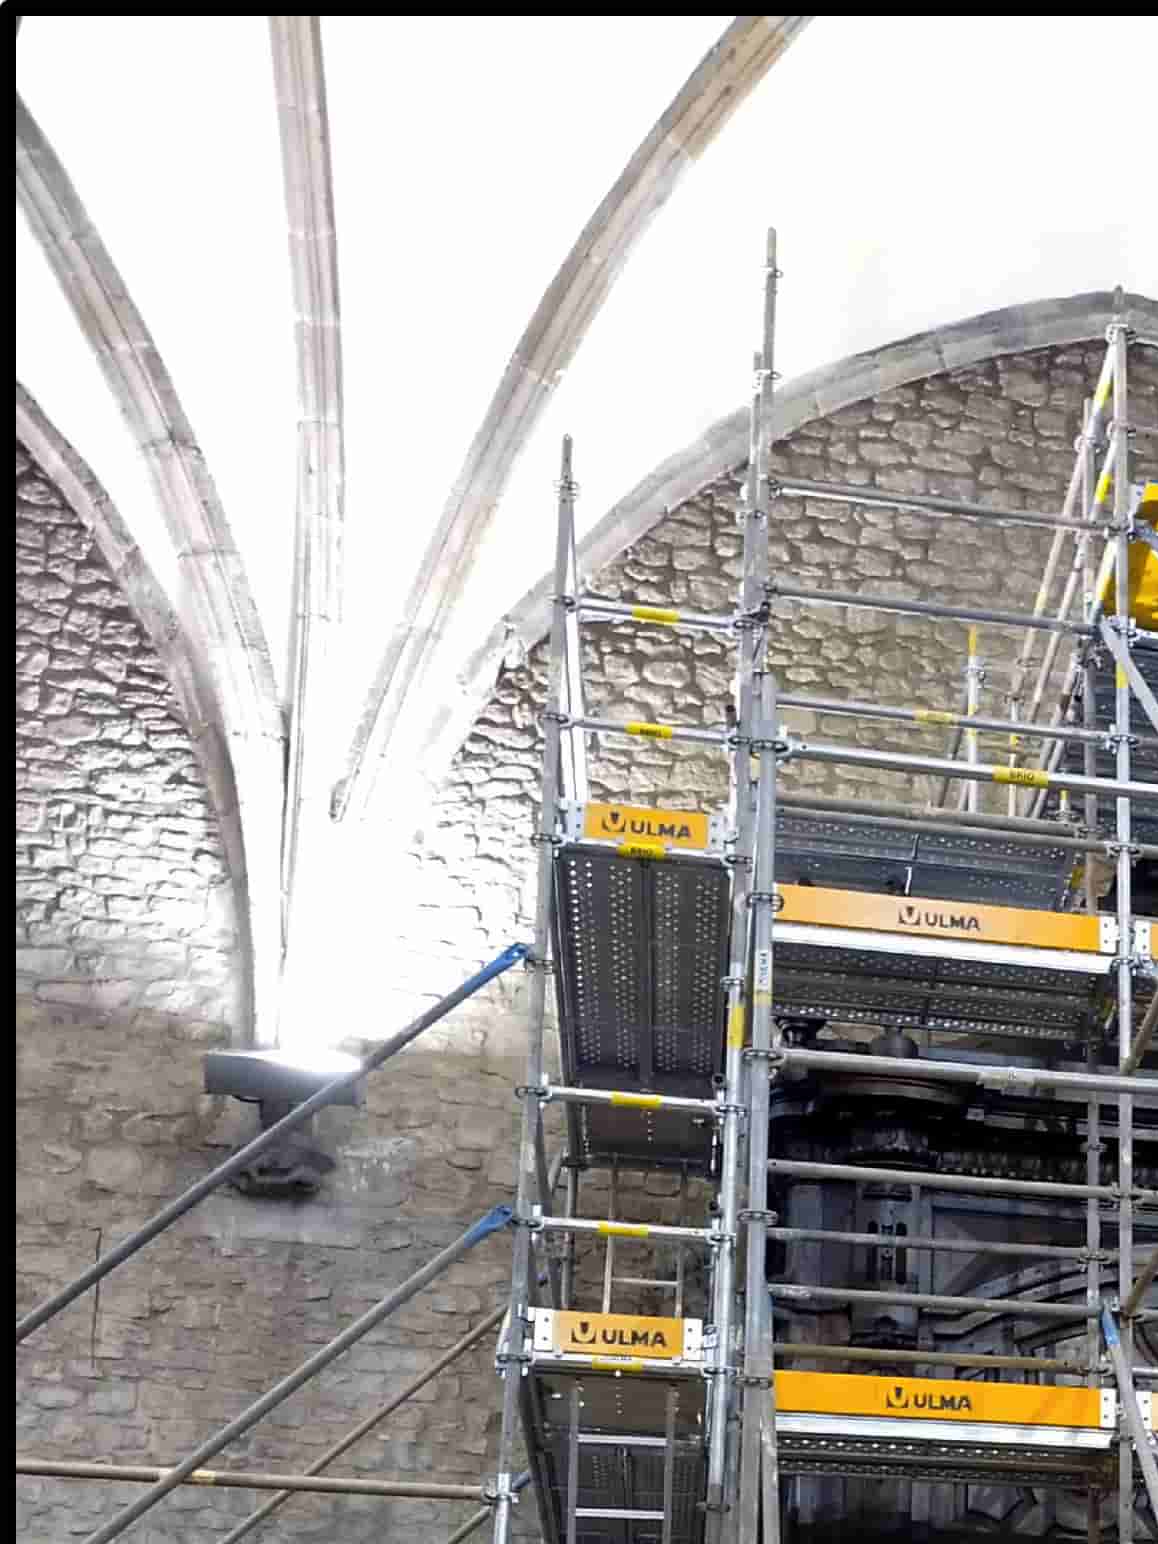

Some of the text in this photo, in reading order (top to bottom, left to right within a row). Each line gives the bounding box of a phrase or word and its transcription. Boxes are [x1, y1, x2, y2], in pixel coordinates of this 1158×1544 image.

[631, 820, 692, 838] ULMA
[925, 913, 981, 930] ULMA
[602, 1329, 667, 1347] ULMA
[913, 1395, 971, 1411] ULMA
